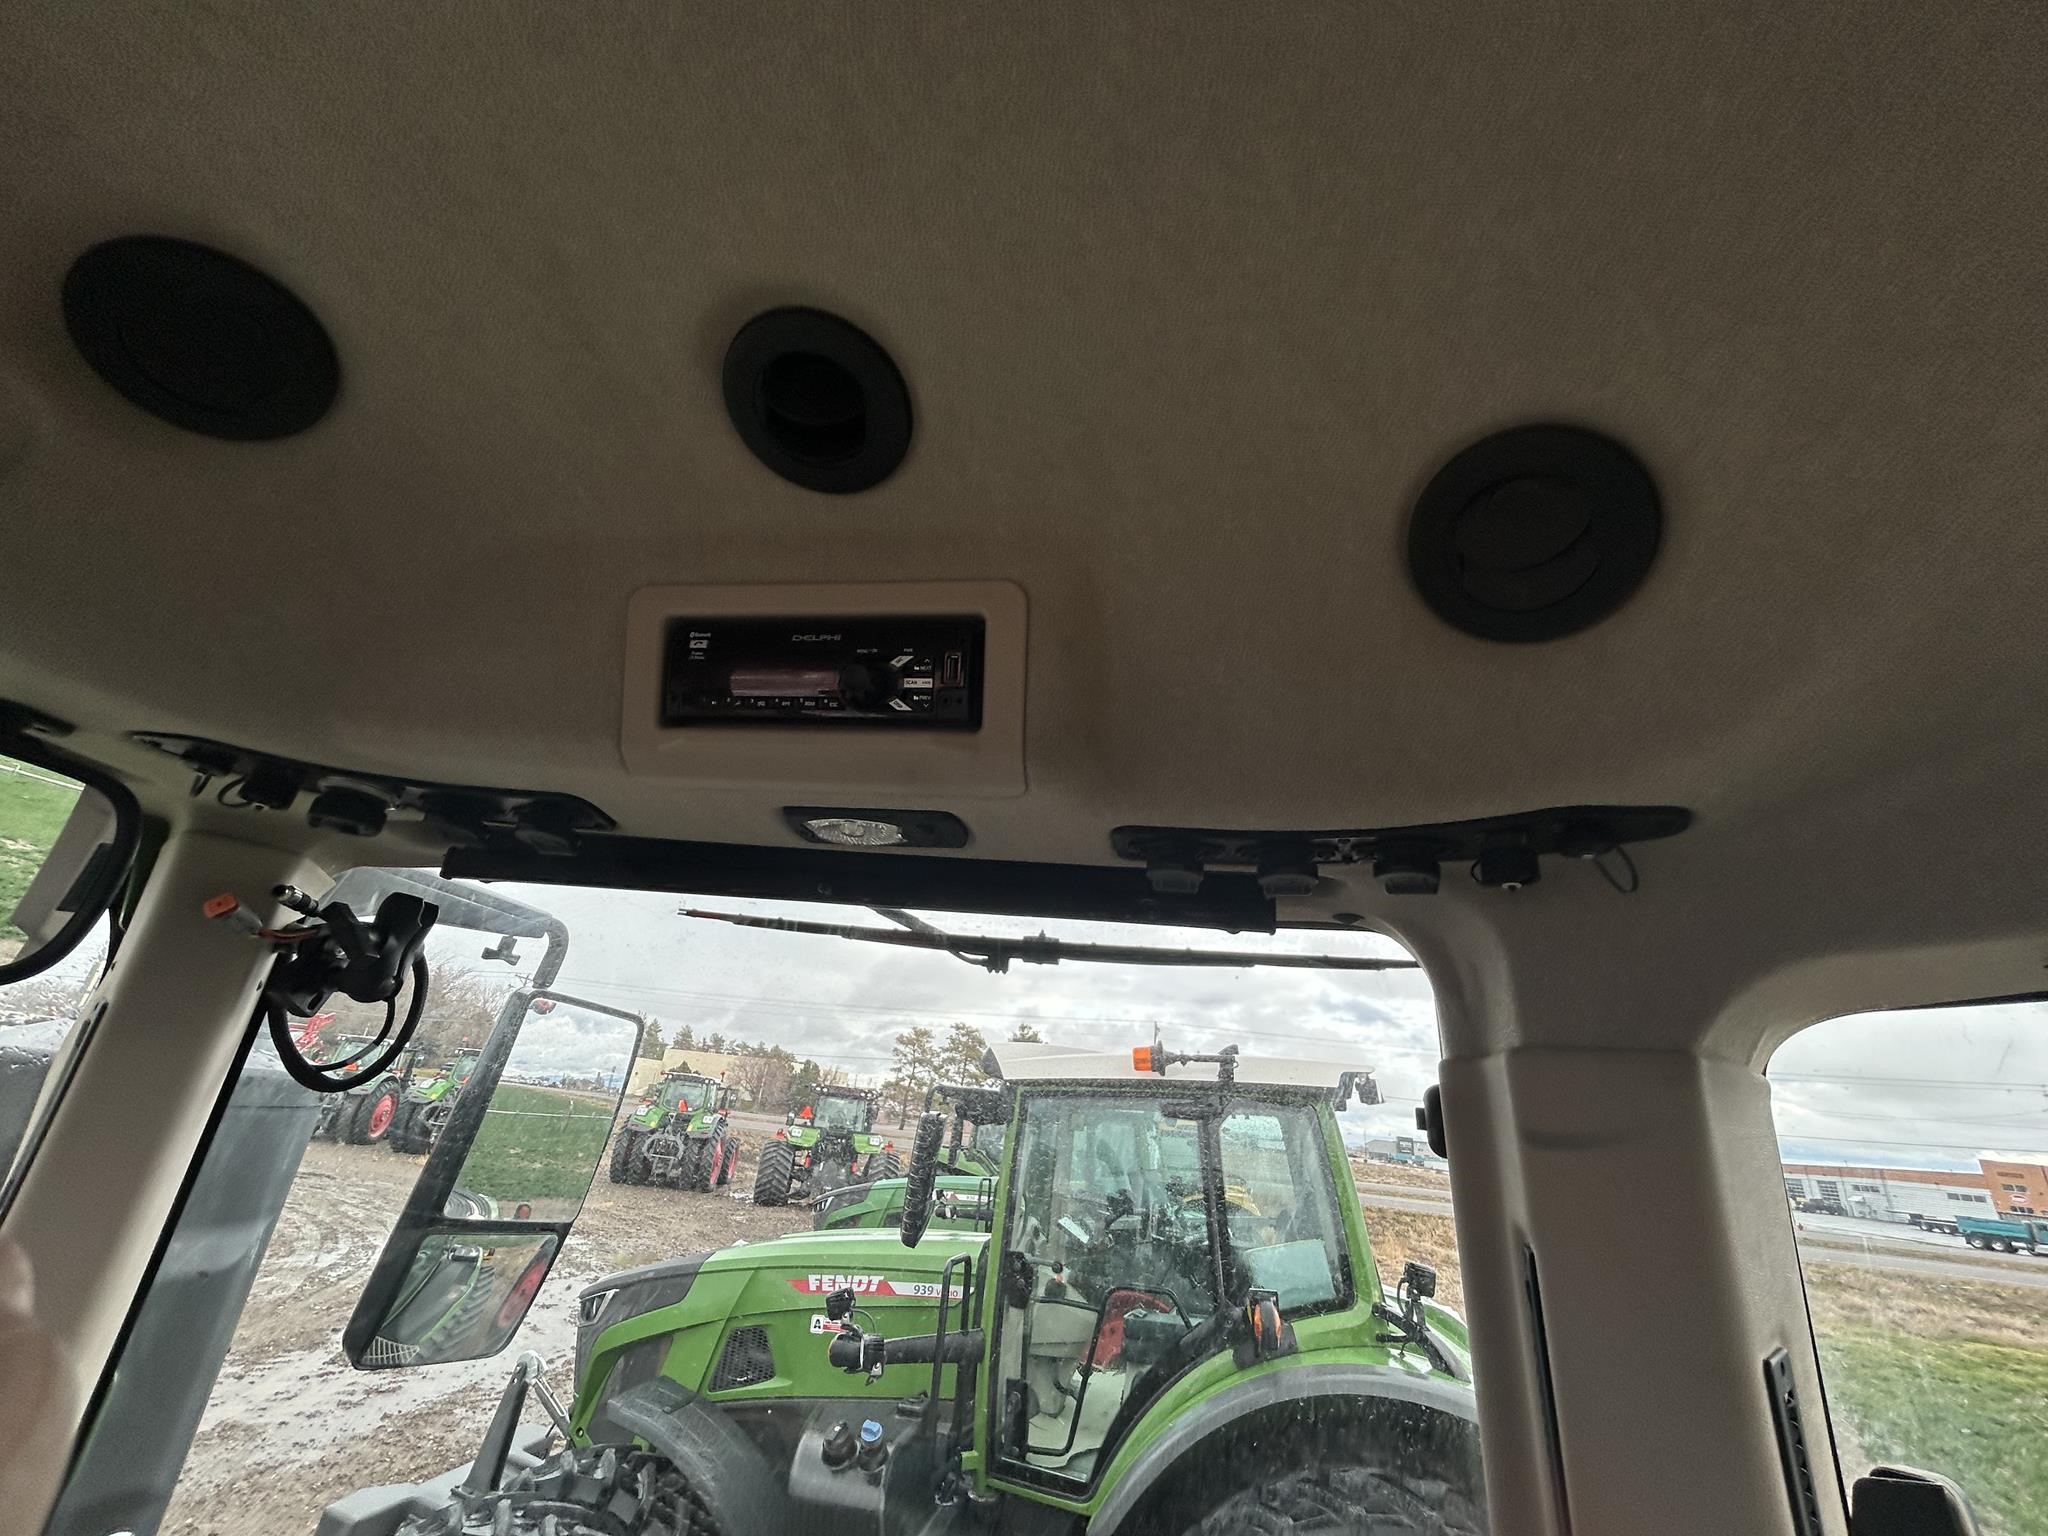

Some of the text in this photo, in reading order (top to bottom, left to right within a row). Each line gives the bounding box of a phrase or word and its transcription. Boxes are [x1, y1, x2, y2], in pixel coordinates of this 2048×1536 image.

[791, 634, 842, 642] DELPHI
[808, 1274, 959, 1298] FENDT 939 VIO
[813, 1319, 822, 1330] A
